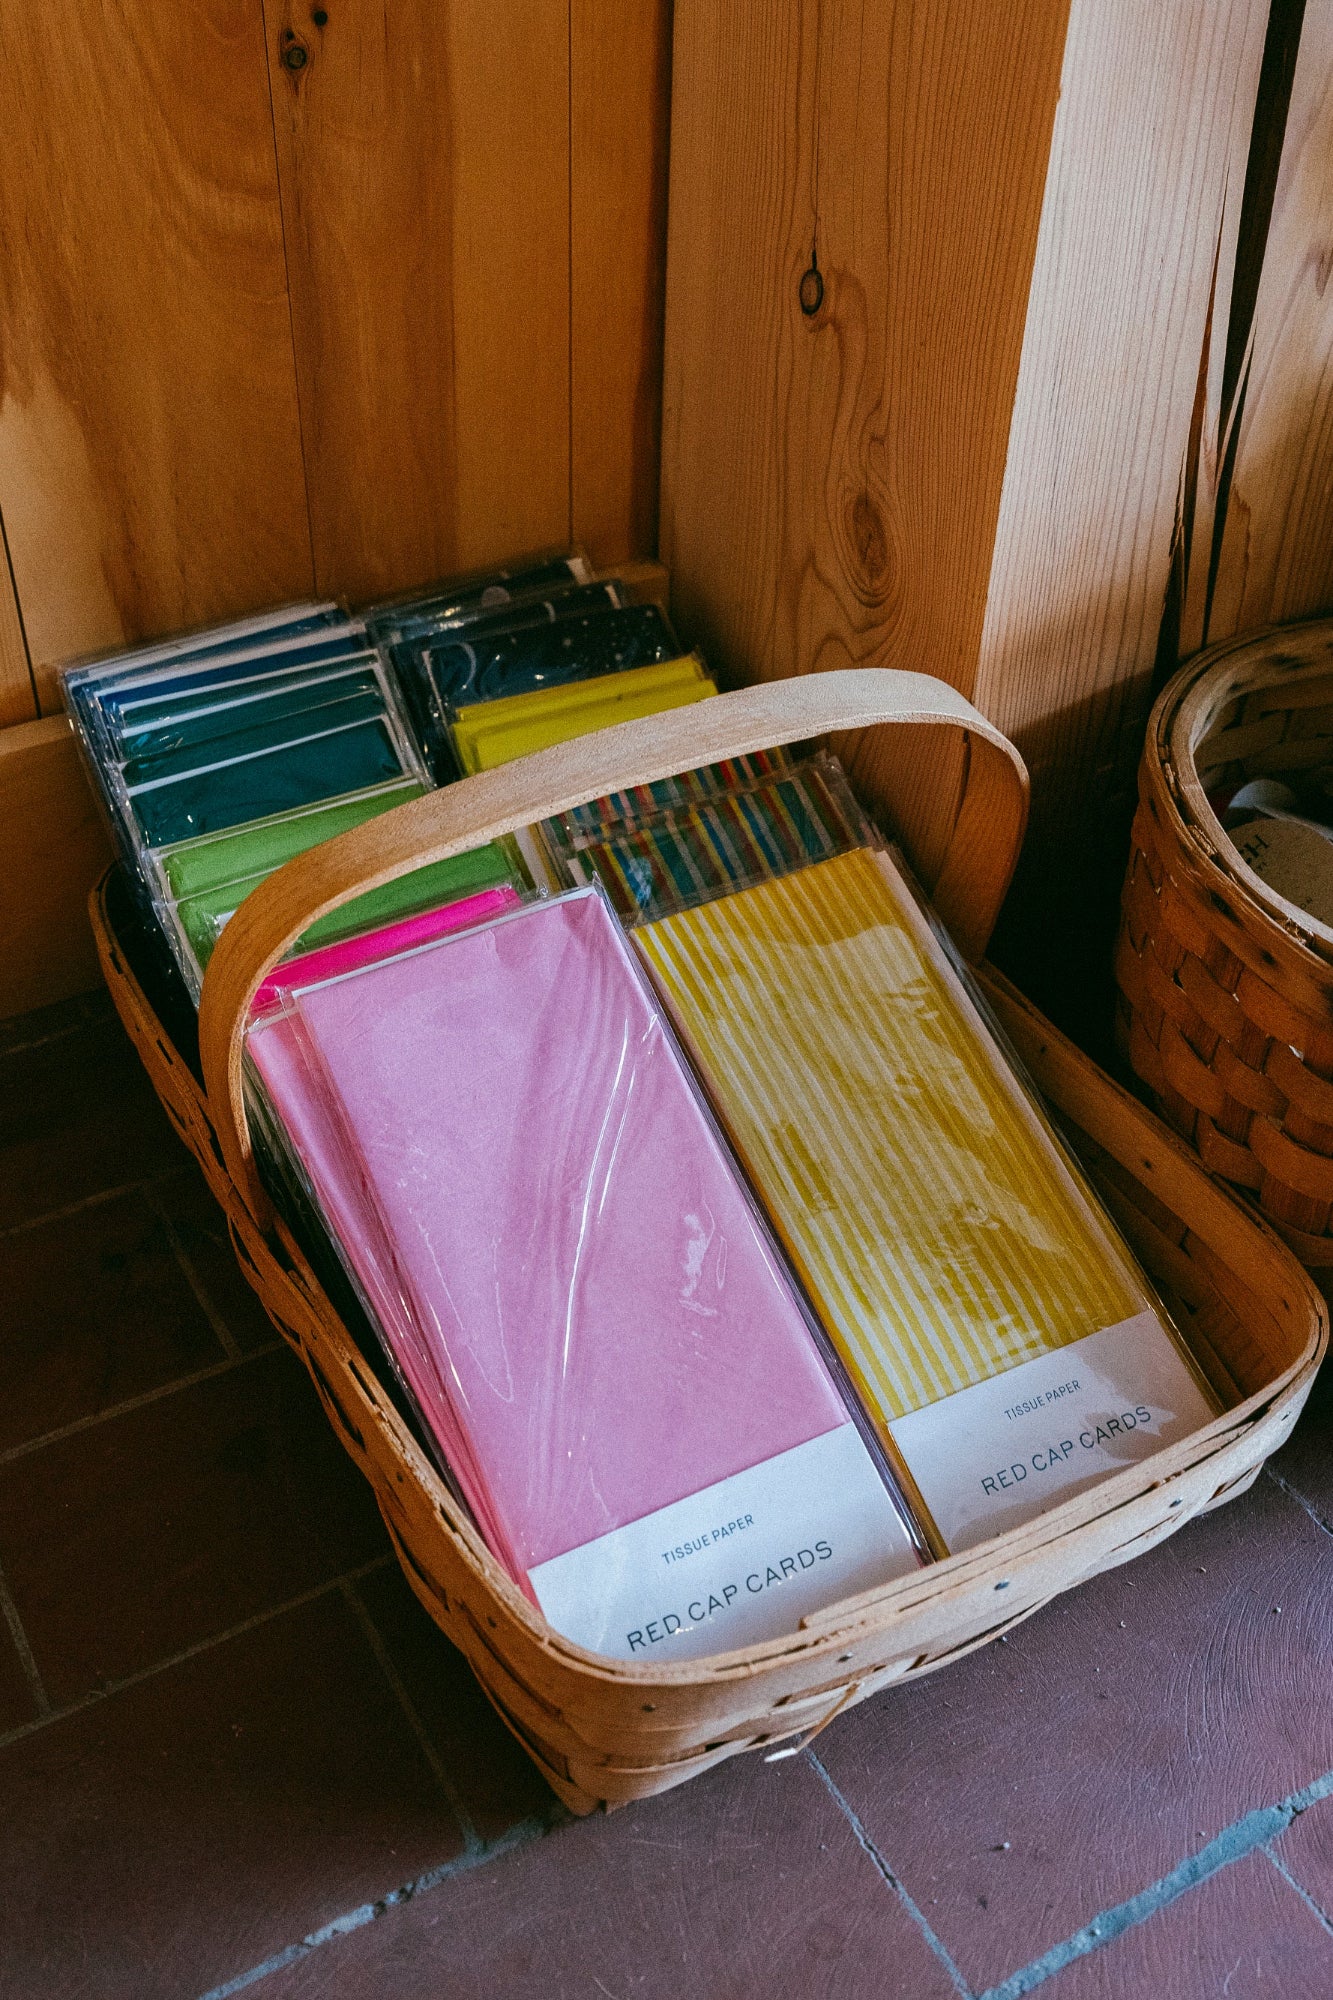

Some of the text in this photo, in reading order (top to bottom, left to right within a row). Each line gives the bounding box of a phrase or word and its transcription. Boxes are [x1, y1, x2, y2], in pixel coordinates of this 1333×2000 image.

[1004, 1380, 1081, 1421] TISSUE PAPER
[981, 1406, 1152, 1496] RED CAP CARDS
[661, 1514, 755, 1565] TISSUE PAPER
[626, 1541, 833, 1652] RED CAP CARDS
